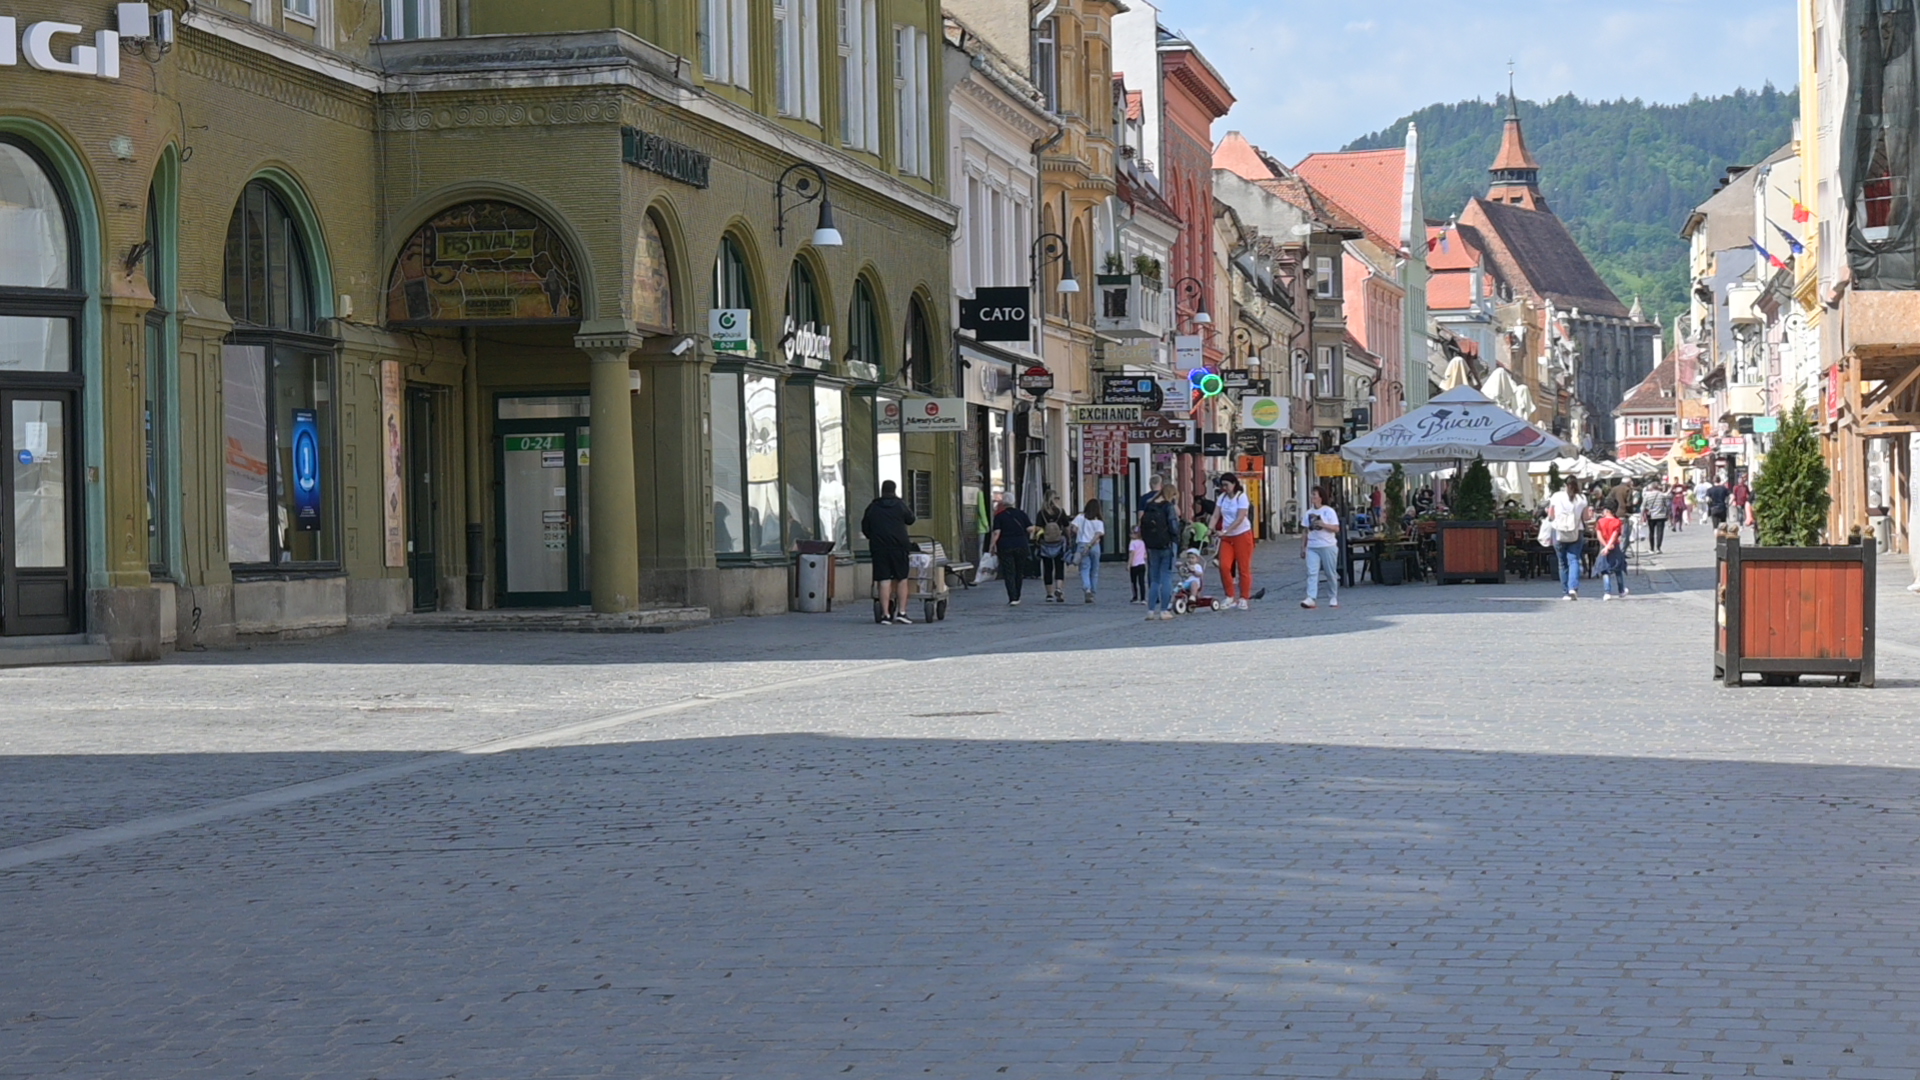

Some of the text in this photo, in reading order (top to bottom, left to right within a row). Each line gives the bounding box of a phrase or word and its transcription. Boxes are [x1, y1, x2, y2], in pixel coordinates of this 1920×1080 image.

[0, 17, 119, 78] IGI
[979, 307, 1025, 321] CATO
[1079, 408, 1139, 420] EXCHANGE
[1417, 415, 1493, 439] Bucur
[1128, 429, 1151, 439] REET
[520, 437, 552, 450] 0-24
